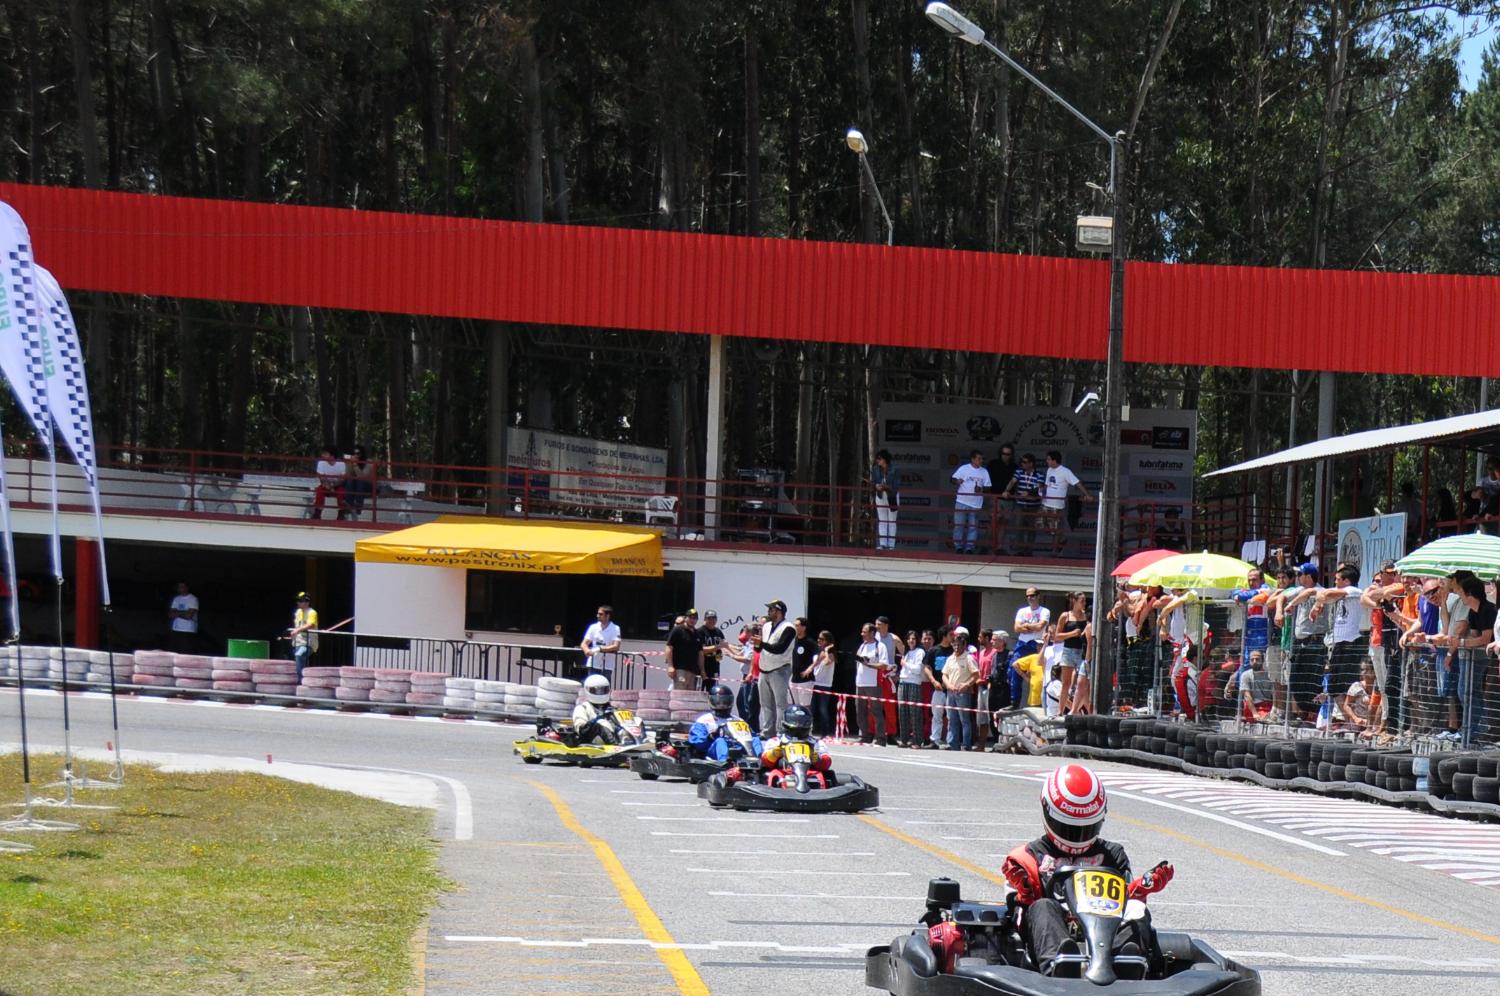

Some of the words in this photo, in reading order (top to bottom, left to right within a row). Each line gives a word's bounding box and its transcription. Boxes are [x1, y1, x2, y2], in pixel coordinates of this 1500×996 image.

[394, 554, 562, 573] www.pestronix.pt
[1060, 801, 1100, 815] parmalat
[1077, 874, 1121, 901] 136
